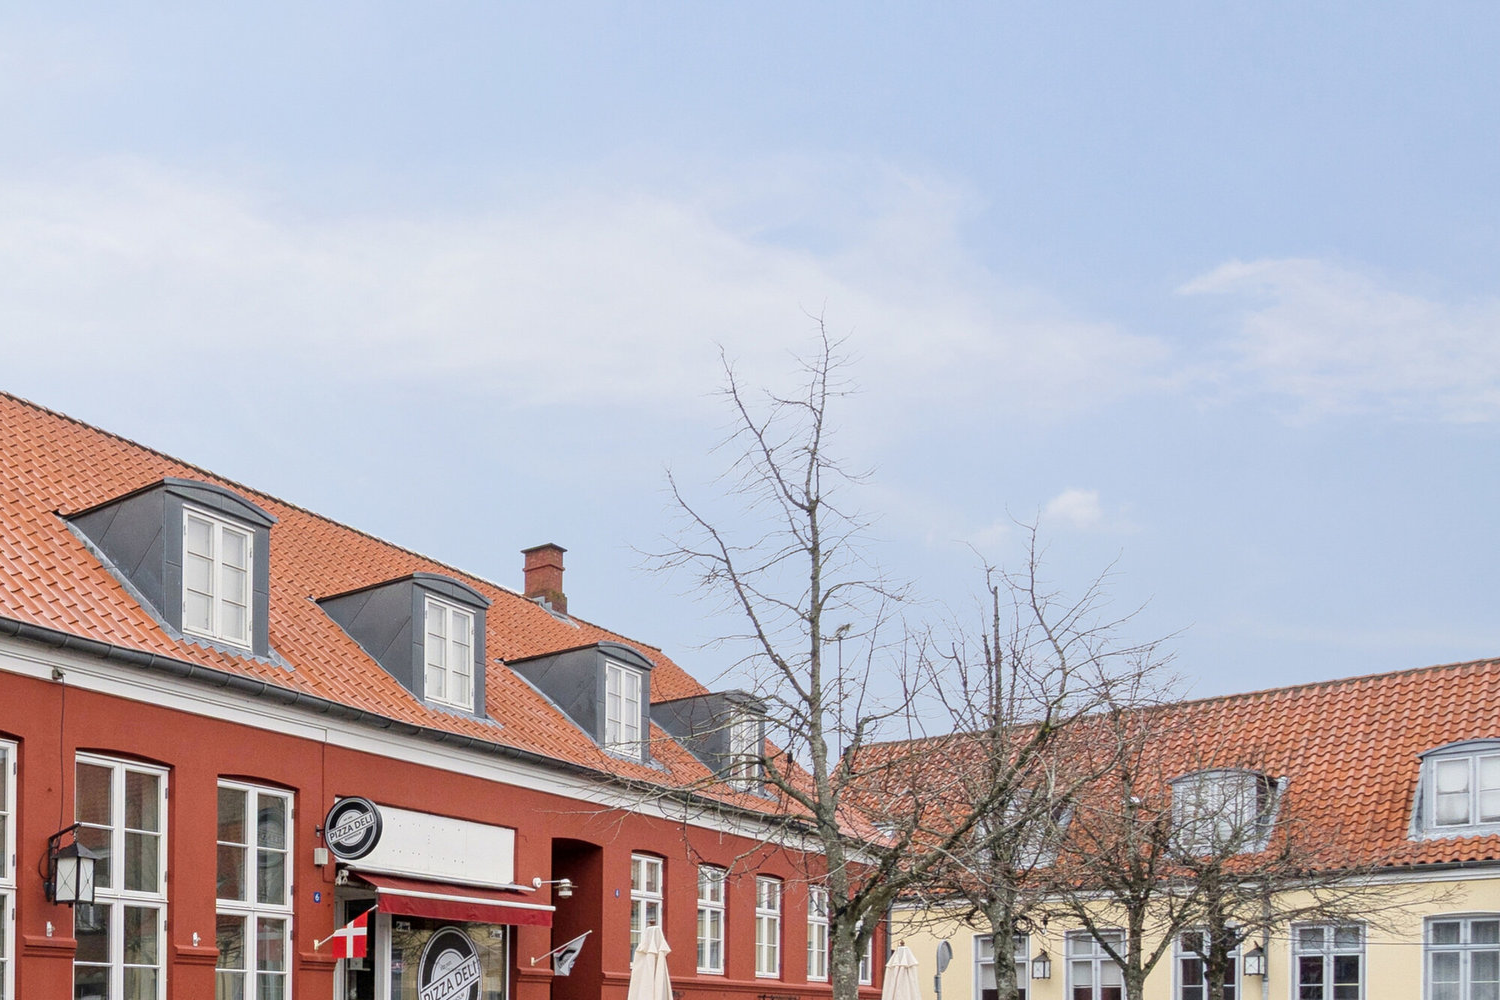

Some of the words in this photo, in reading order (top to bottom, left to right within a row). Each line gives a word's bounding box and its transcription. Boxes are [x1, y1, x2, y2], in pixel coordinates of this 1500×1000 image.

[329, 825, 354, 841] PIZZA
[354, 814, 373, 829] DELI
[315, 893, 320, 902] 6
[455, 960, 477, 986] DELI
